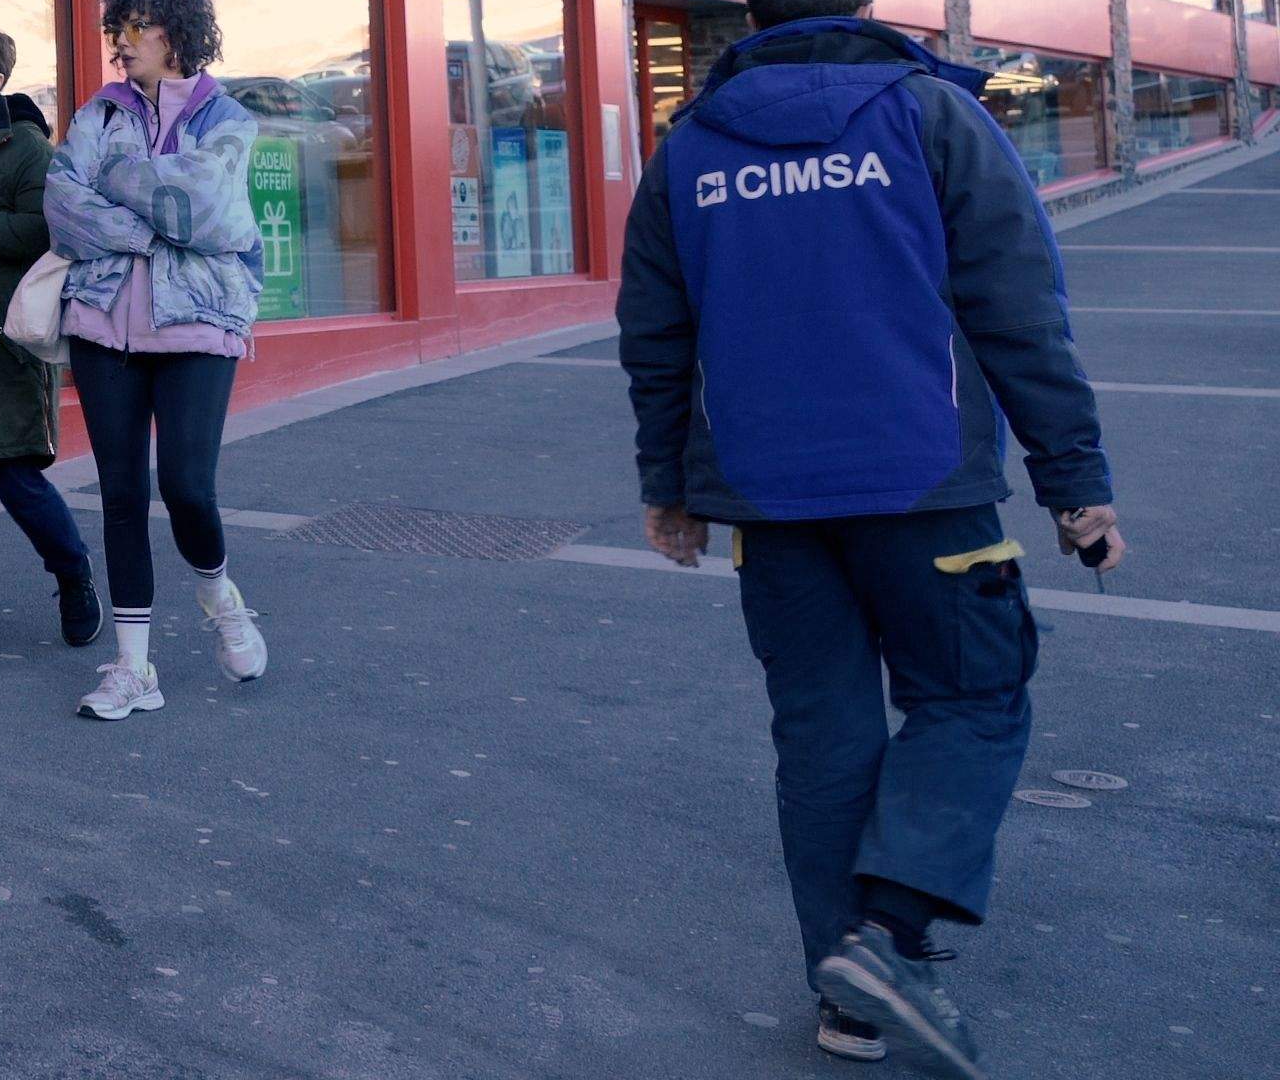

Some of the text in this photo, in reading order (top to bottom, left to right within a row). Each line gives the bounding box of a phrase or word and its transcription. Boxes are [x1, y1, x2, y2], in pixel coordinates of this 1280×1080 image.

[253, 151, 292, 172] CADEAU
[255, 171, 292, 191] OFFERT
[735, 150, 892, 202] CIMSA
